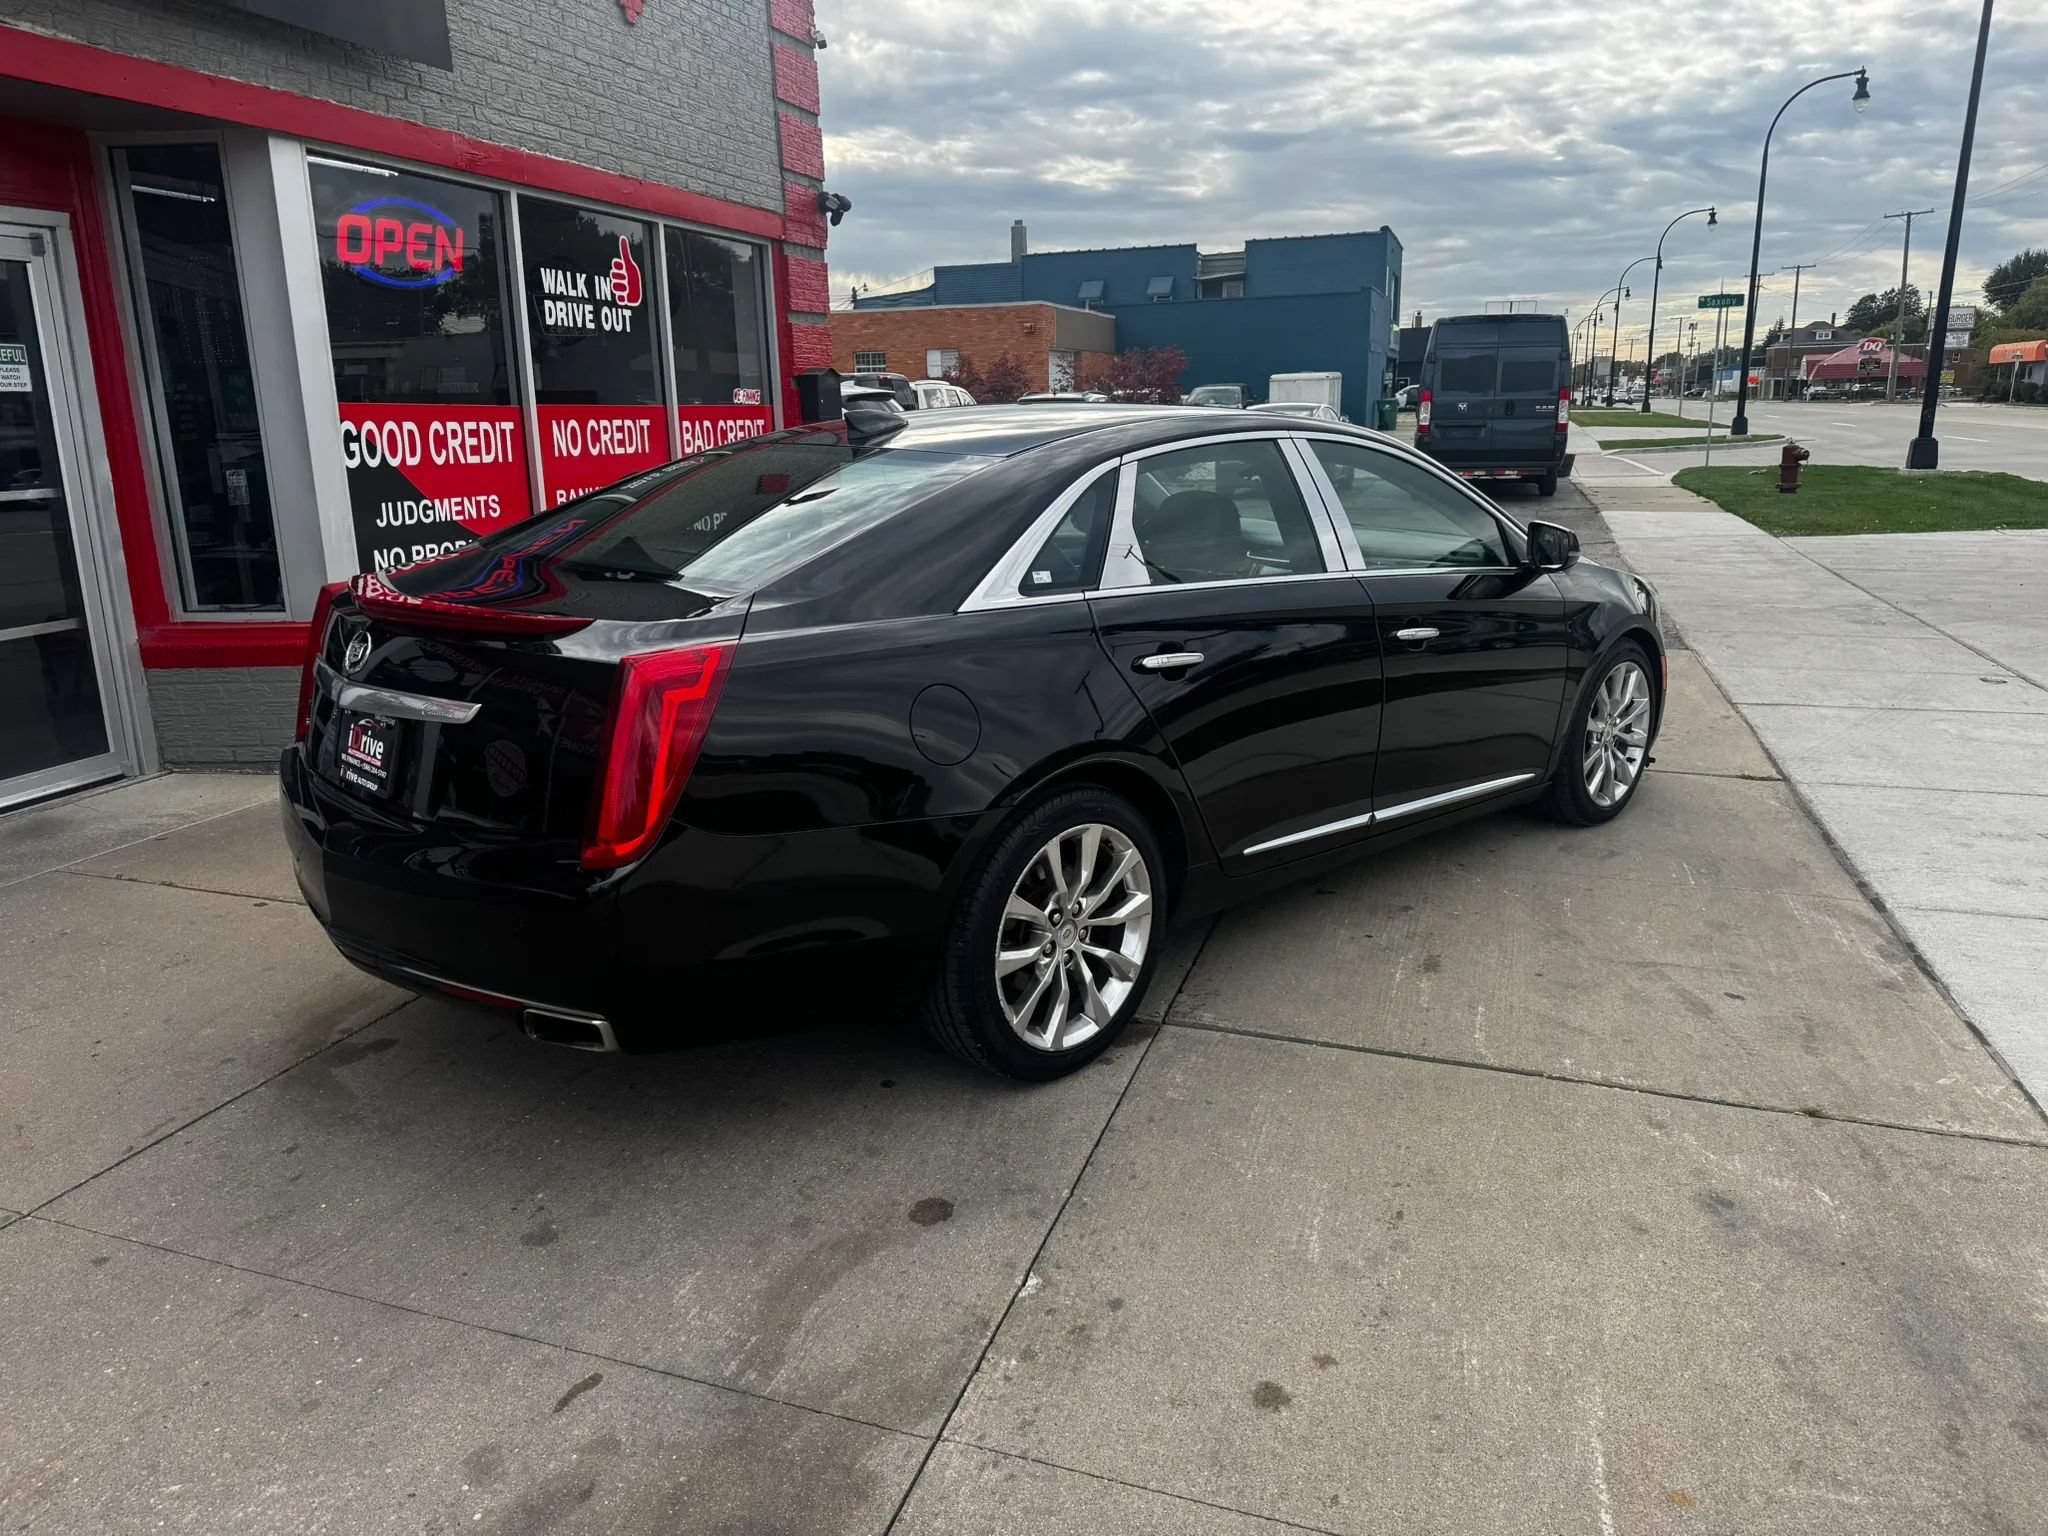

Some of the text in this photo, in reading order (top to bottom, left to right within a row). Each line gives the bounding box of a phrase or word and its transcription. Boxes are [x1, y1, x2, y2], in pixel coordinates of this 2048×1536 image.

[336, 213, 464, 273] OPEN
[540, 267, 612, 302] WALK IN
[544, 299, 632, 333] DRIVE OUT
[1706, 297, 1738, 307] Saxony
[1948, 312, 1974, 323] BURGER
[0, 349, 26, 362] EFUL
[1863, 341, 1882, 351] DQ
[340, 420, 515, 469] GOOD CREDIT
[552, 418, 650, 457] NO CREDIT
[682, 419, 765, 454] BAD CREDIT
[376, 495, 501, 528] JUDGMENTS
[373, 540, 473, 573] NO PRO
[348, 723, 384, 760] iDrive
